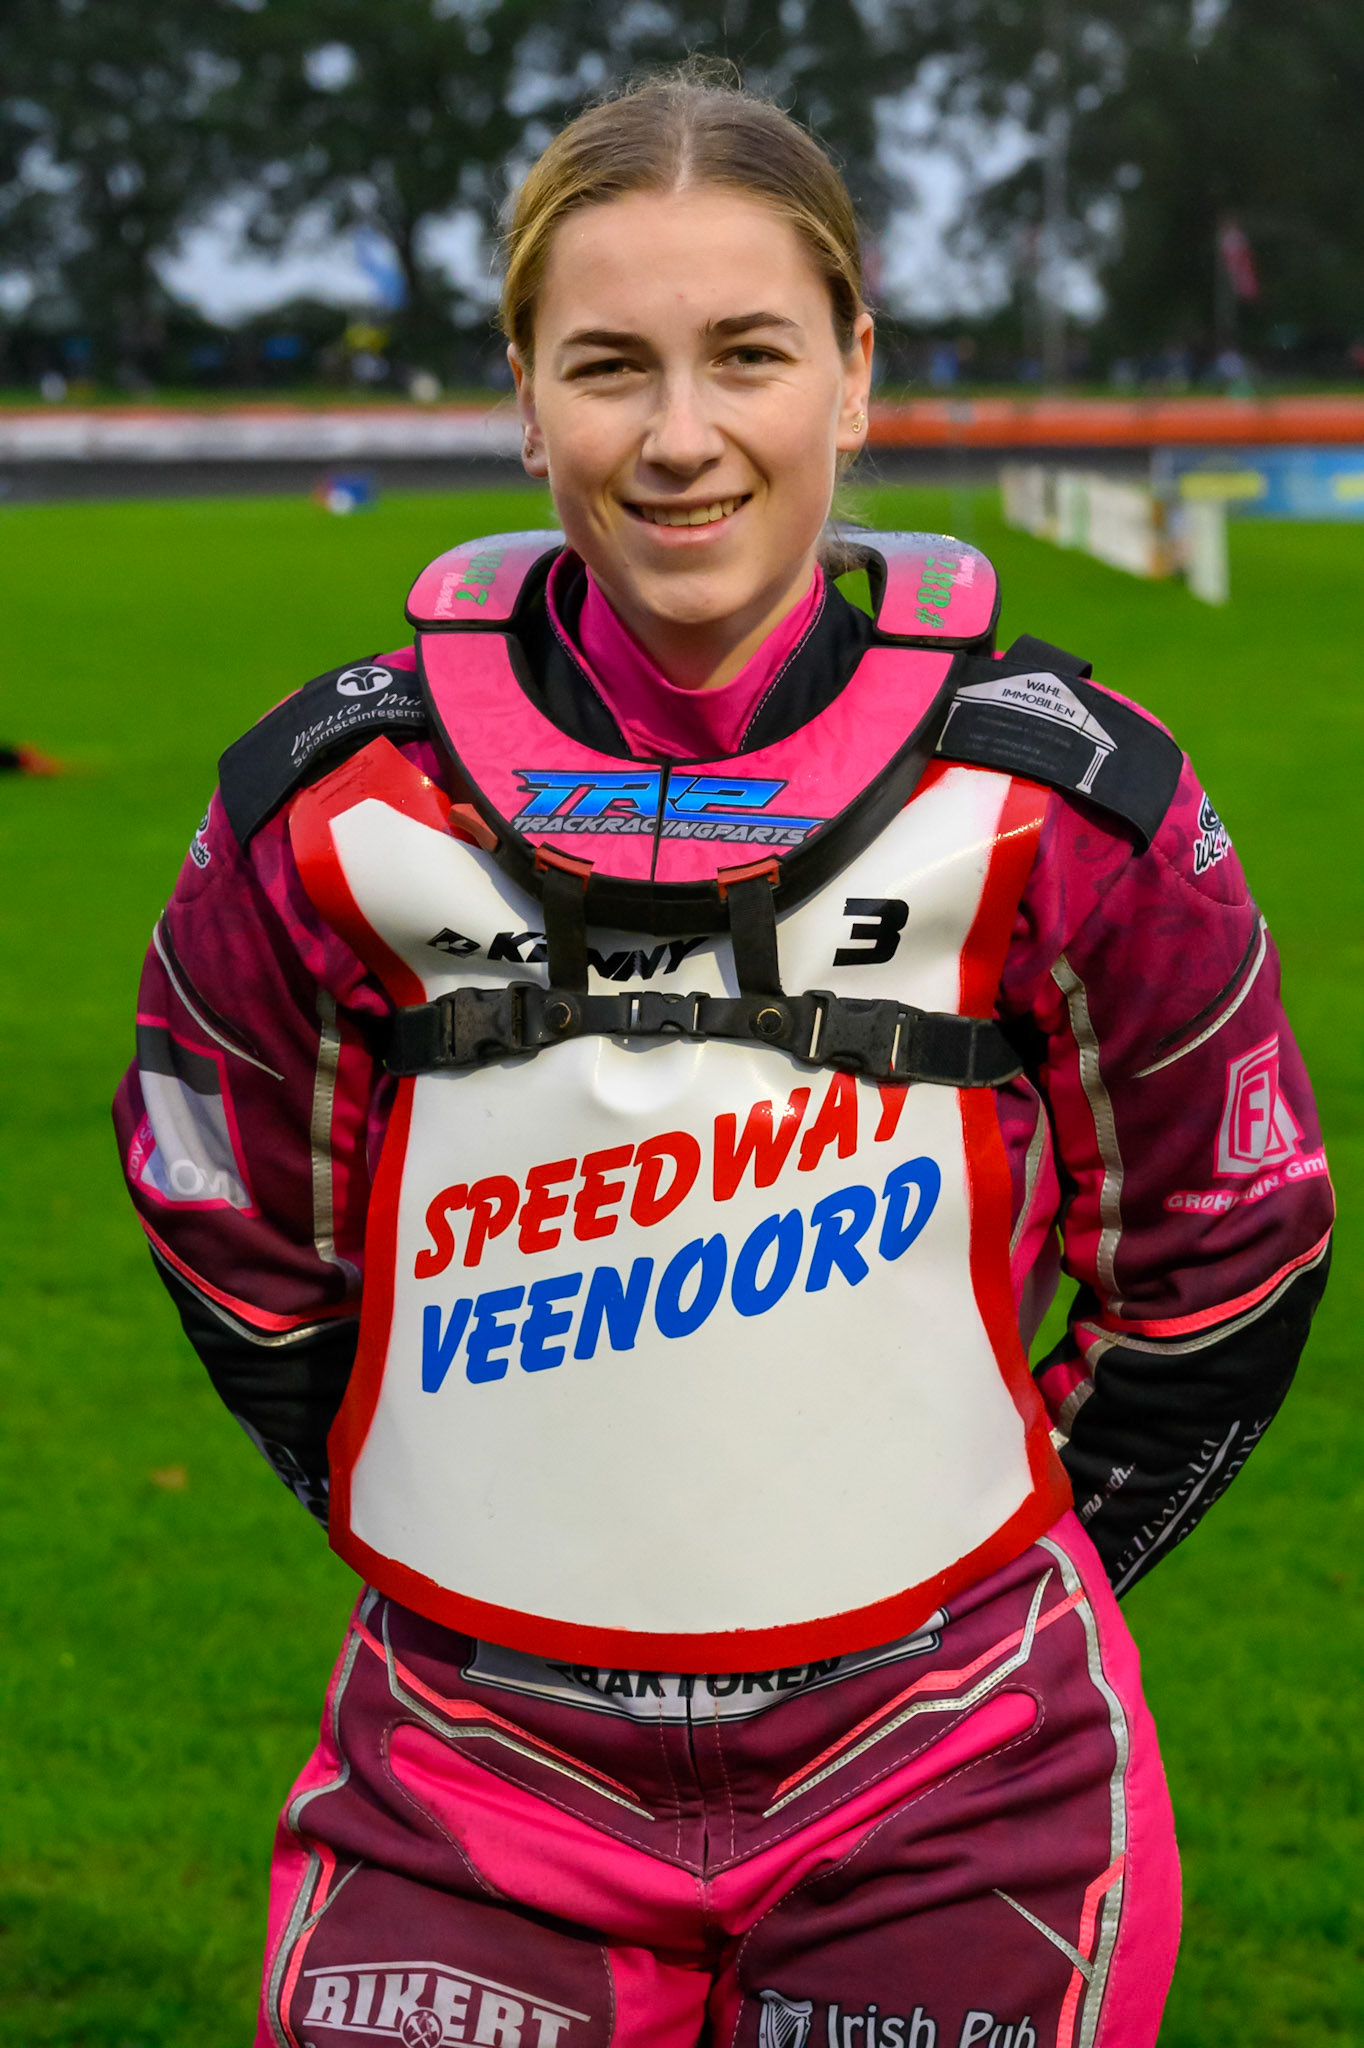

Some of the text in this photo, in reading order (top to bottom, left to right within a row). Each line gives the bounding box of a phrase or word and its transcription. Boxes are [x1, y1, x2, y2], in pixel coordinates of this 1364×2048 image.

[1002, 688, 1076, 718] IMMOBILIEN
[1027, 679, 1062, 699] WAHL
[291, 704, 361, 756] Mario
[833, 898, 909, 966] 3
[414, 1070, 911, 1279] SPEEDWAY
[422, 1157, 942, 1394] VEENOORD
[303, 1973, 571, 2048] RIKERT
[828, 2004, 1036, 2048] Irish Pub
